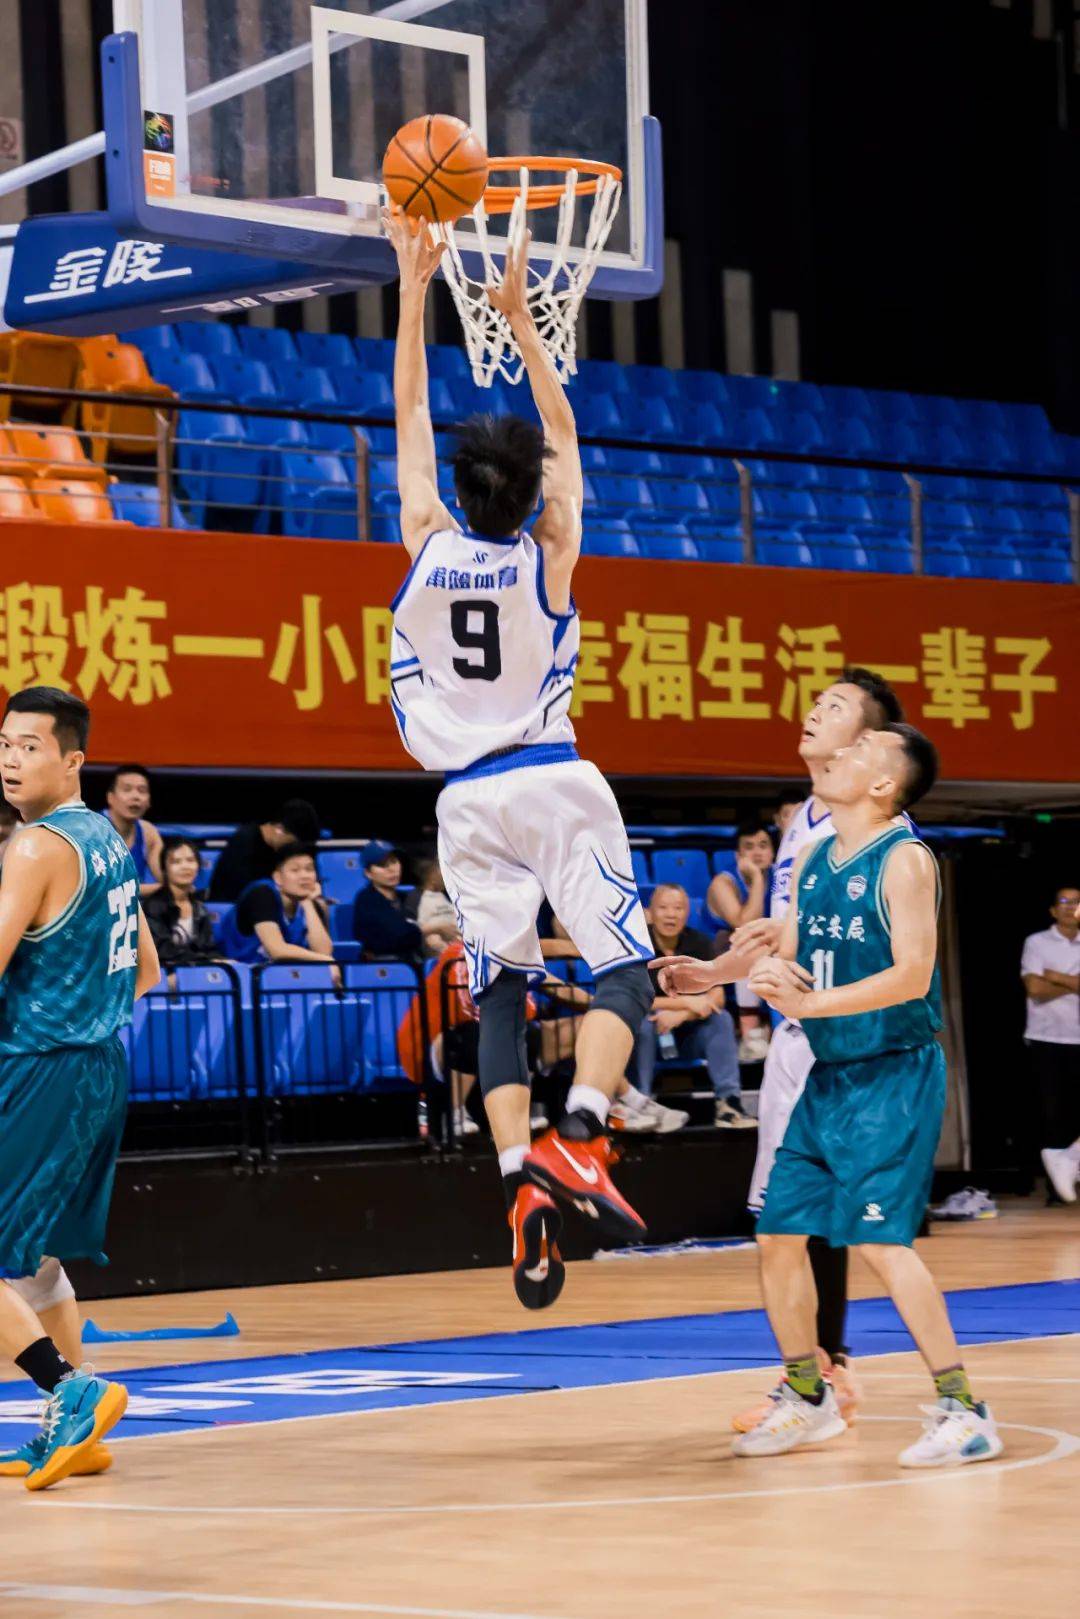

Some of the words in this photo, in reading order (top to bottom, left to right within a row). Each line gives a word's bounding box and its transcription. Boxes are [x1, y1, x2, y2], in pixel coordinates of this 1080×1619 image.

[24, 239, 192, 304] 金陵
[450, 600, 501, 682] 9
[810, 949, 835, 991] 11
